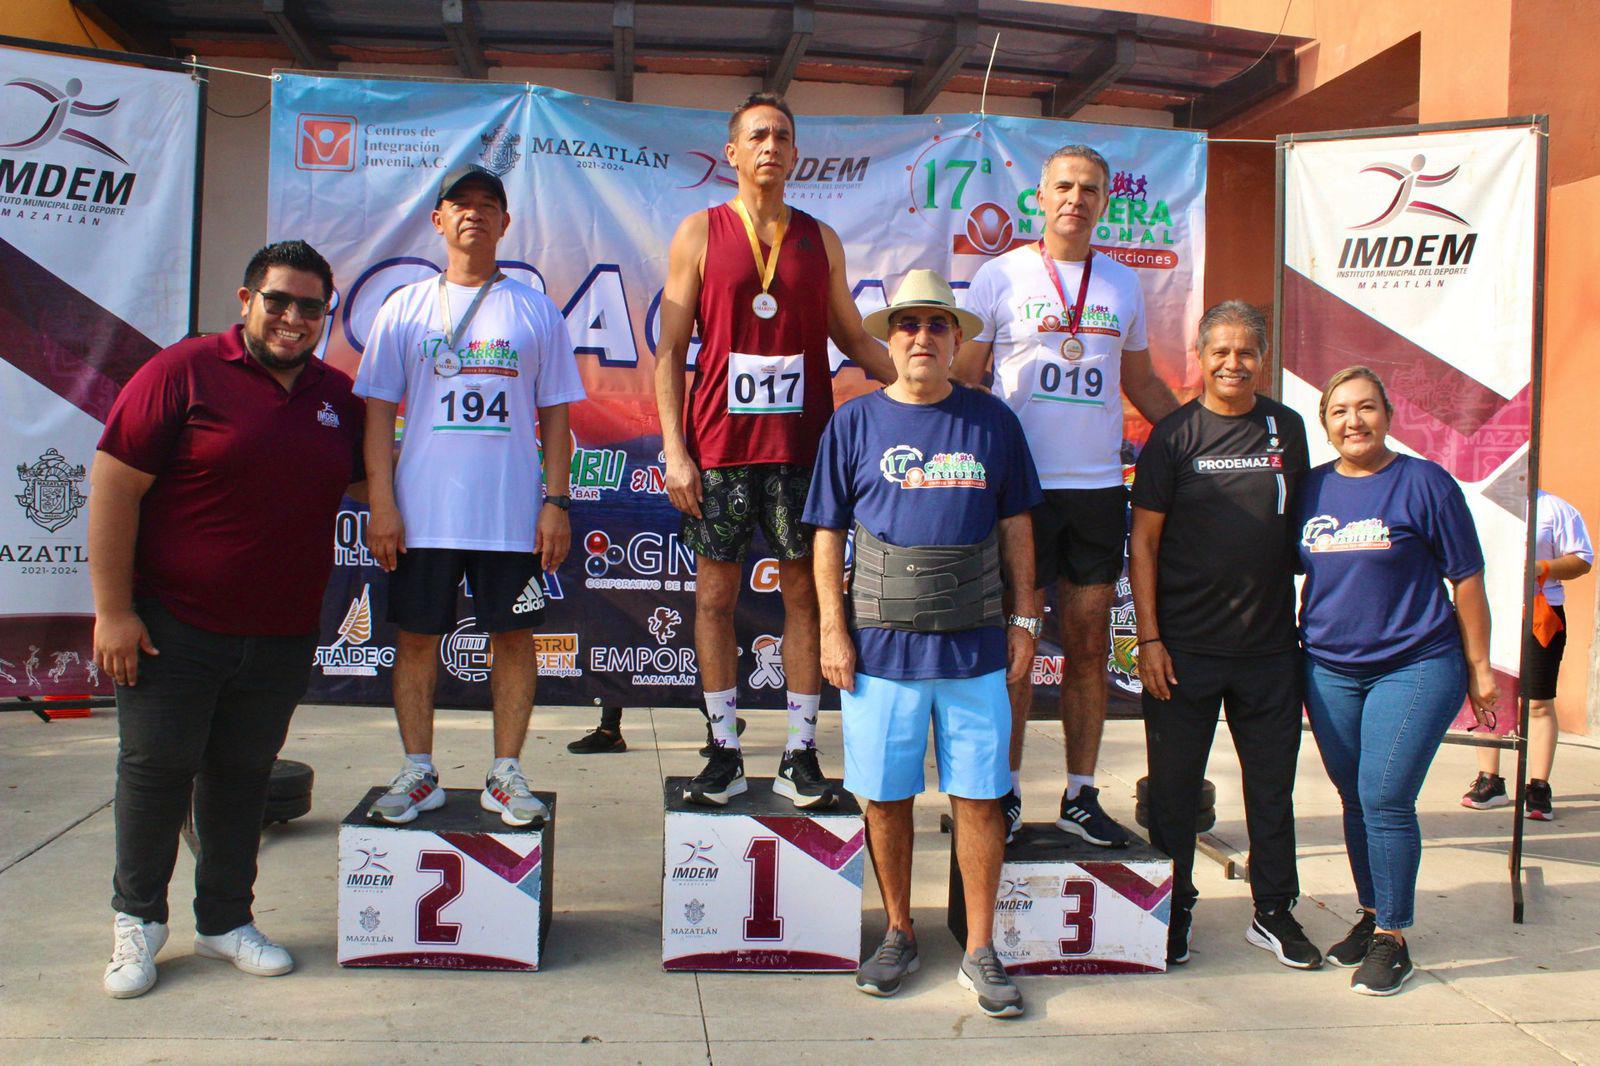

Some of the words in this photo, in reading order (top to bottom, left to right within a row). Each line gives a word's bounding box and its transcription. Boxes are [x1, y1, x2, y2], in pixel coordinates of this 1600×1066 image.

[365, 124, 417, 137] Centros
[421, 126, 436, 137] de
[364, 140, 440, 156] Integración
[532, 137, 670, 170] MAZATLÁN
[362, 156, 414, 169] Juvenil,
[418, 156, 448, 169] A.C.
[577, 160, 625, 172] 2021-2024
[785, 156, 871, 182] DEM
[0, 159, 136, 206] MDEM
[23, 198, 69, 210] MUNICIPAL
[72, 204, 89, 212] DEL
[89, 205, 125, 216] DEPORTE
[1017, 188, 1174, 227] CERA
[1018, 218, 1174, 244] NONAL
[1106, 250, 1172, 265] dicciones
[1338, 233, 1478, 269] IMDEM
[1336, 270, 1374, 278] INSTITUTO
[1376, 269, 1416, 277] MUNICIPAL
[1418, 268, 1432, 276] DEL
[1434, 267, 1468, 275] DEPORTE
[458, 348, 519, 361] CARRERA
[465, 359, 519, 368] ACIONAL
[1040, 363, 1103, 397] 019
[734, 372, 801, 404] 017
[441, 390, 509, 423] 194
[924, 461, 985, 473] CARRERA
[1198, 457, 1270, 470] PRODEMAZ
[576, 490, 599, 499] BAR
[0, 545, 89, 562] AZATL
[586, 578, 661, 590] CORPORATIVO
[665, 581, 680, 590] DE
[534, 638, 574, 651] STRU
[632, 674, 696, 686] MAZATLÁN
[672, 867, 719, 879] IMDEM
[347, 874, 394, 886] IMDEM
[743, 836, 784, 941] 1
[415, 849, 464, 945] 2
[995, 900, 1033, 910] IMDEM
[1058, 877, 1097, 957] 3
[671, 927, 718, 935] MAZATLÁN
[346, 935, 394, 943] MAZATLÁN
